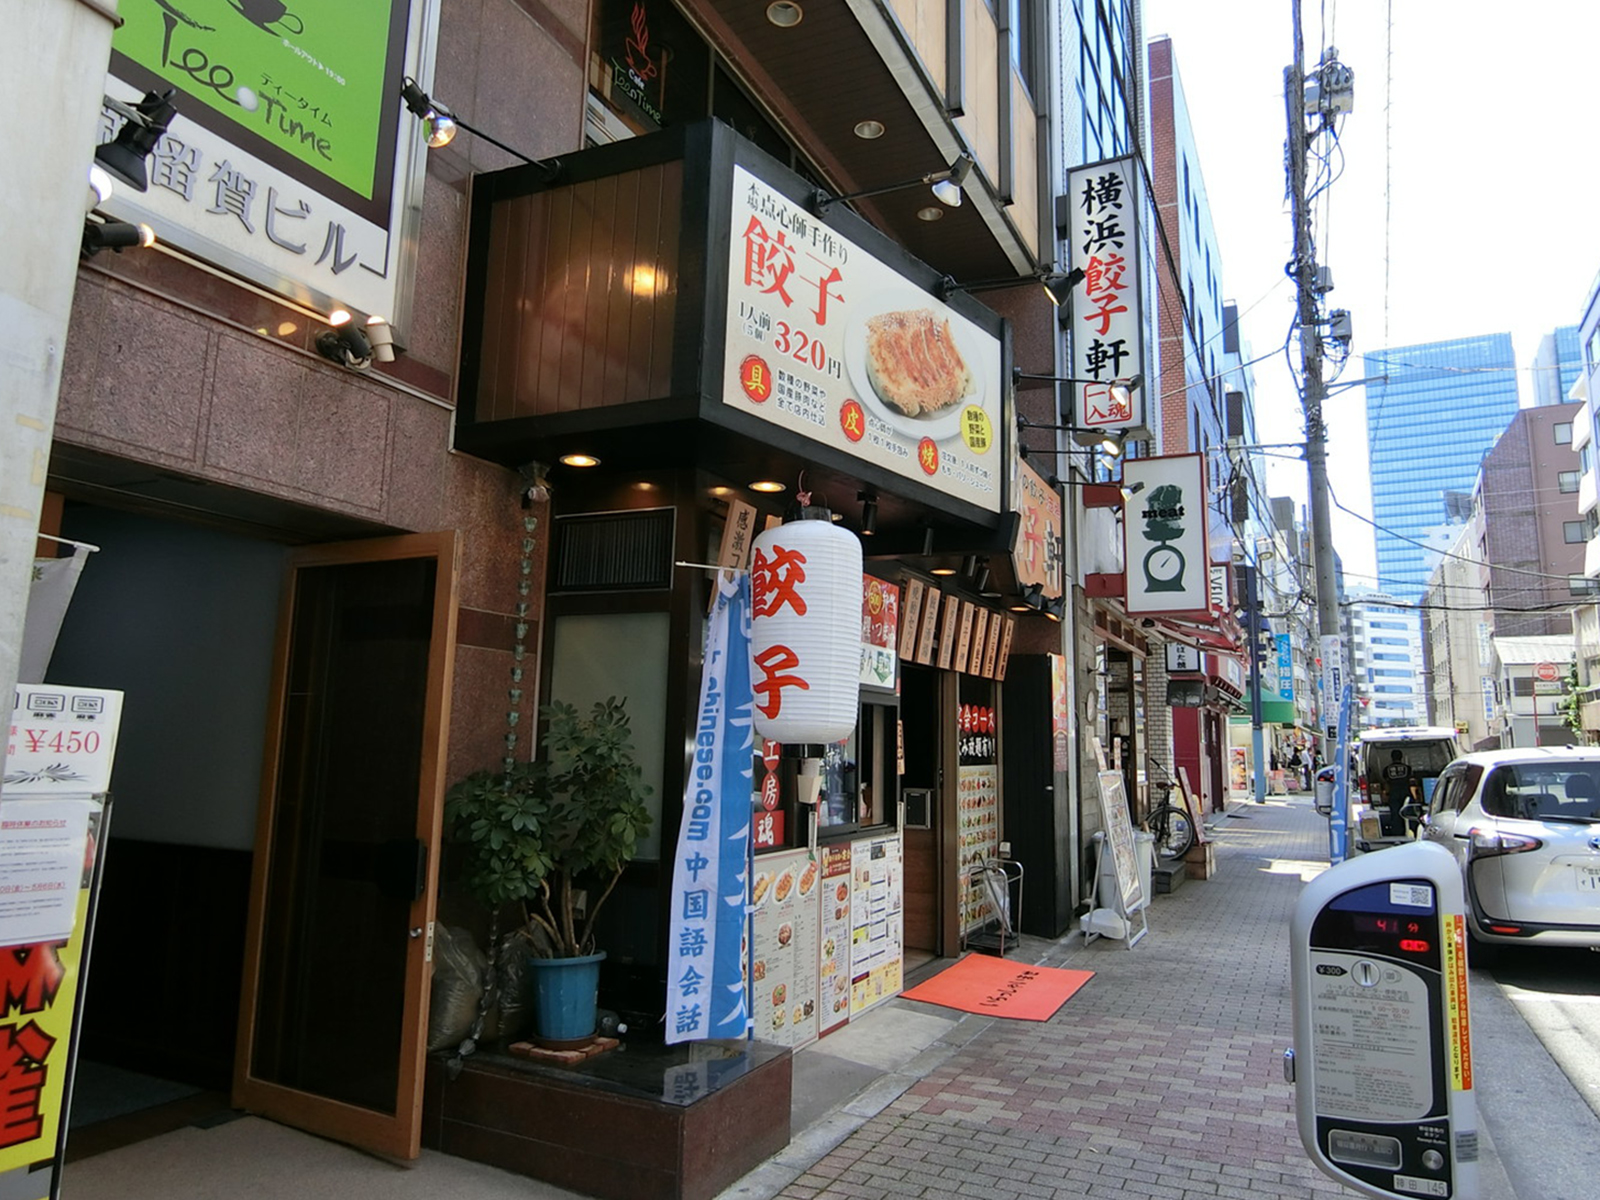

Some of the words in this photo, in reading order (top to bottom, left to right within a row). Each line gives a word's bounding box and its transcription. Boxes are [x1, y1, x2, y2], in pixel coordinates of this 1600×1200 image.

[260, 72, 333, 128] ティータイム
[258, 90, 333, 162] Time
[742, 214, 845, 326] 餃子
[1080, 172, 1130, 380] 横浜餃子軒
[739, 301, 771, 332] 1人前
[774, 320, 842, 379] 320円
[745, 364, 766, 396] 具
[845, 406, 860, 436] 皮
[922, 443, 936, 470] 焼
[1142, 504, 1186, 520] meat
[752, 544, 811, 720] 餃子
[24, 729, 101, 754] ¥450
[676, 851, 710, 1034] 中国語会話
[1427, 1181, 1446, 1197] 145
